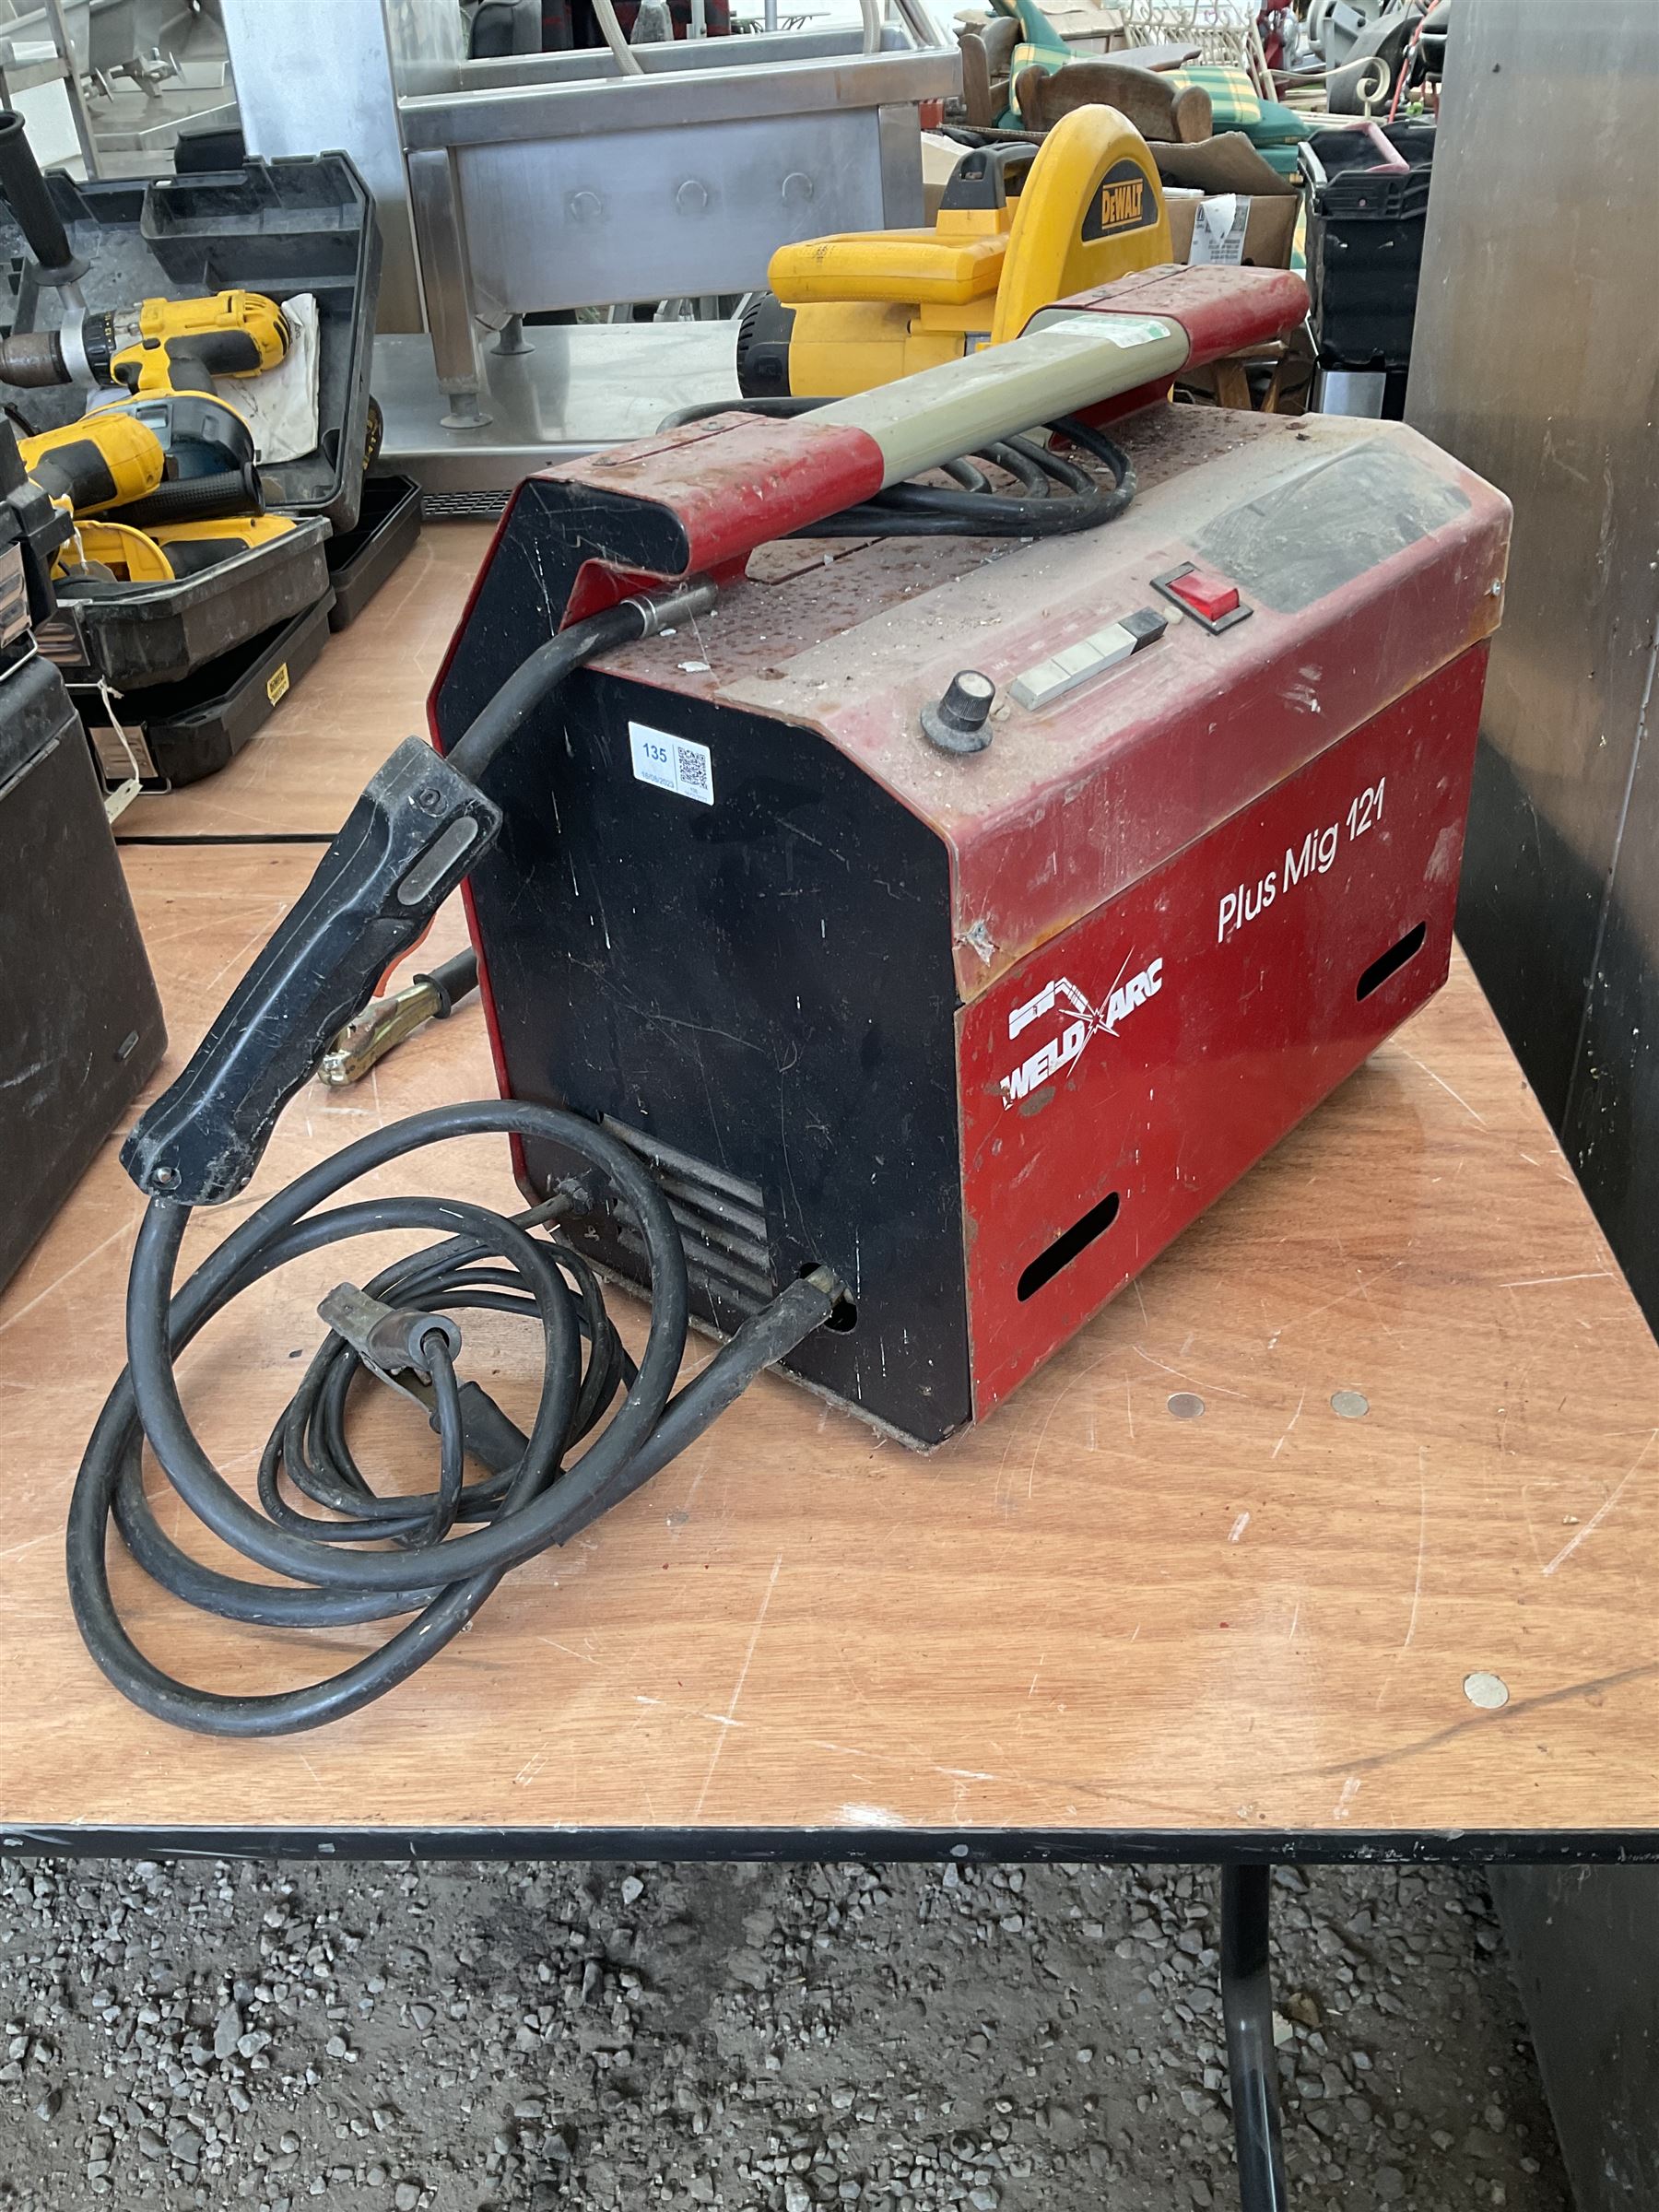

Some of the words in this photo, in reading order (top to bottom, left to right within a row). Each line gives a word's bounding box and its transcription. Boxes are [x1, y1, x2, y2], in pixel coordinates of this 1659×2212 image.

[642, 742, 667, 763] 135
[1218, 871, 1277, 944] Plus
[1282, 822, 1339, 894] Mig
[1346, 776, 1386, 842] 121
[999, 1020, 1085, 1112] WELD
[1105, 957, 1163, 1028] ARC
